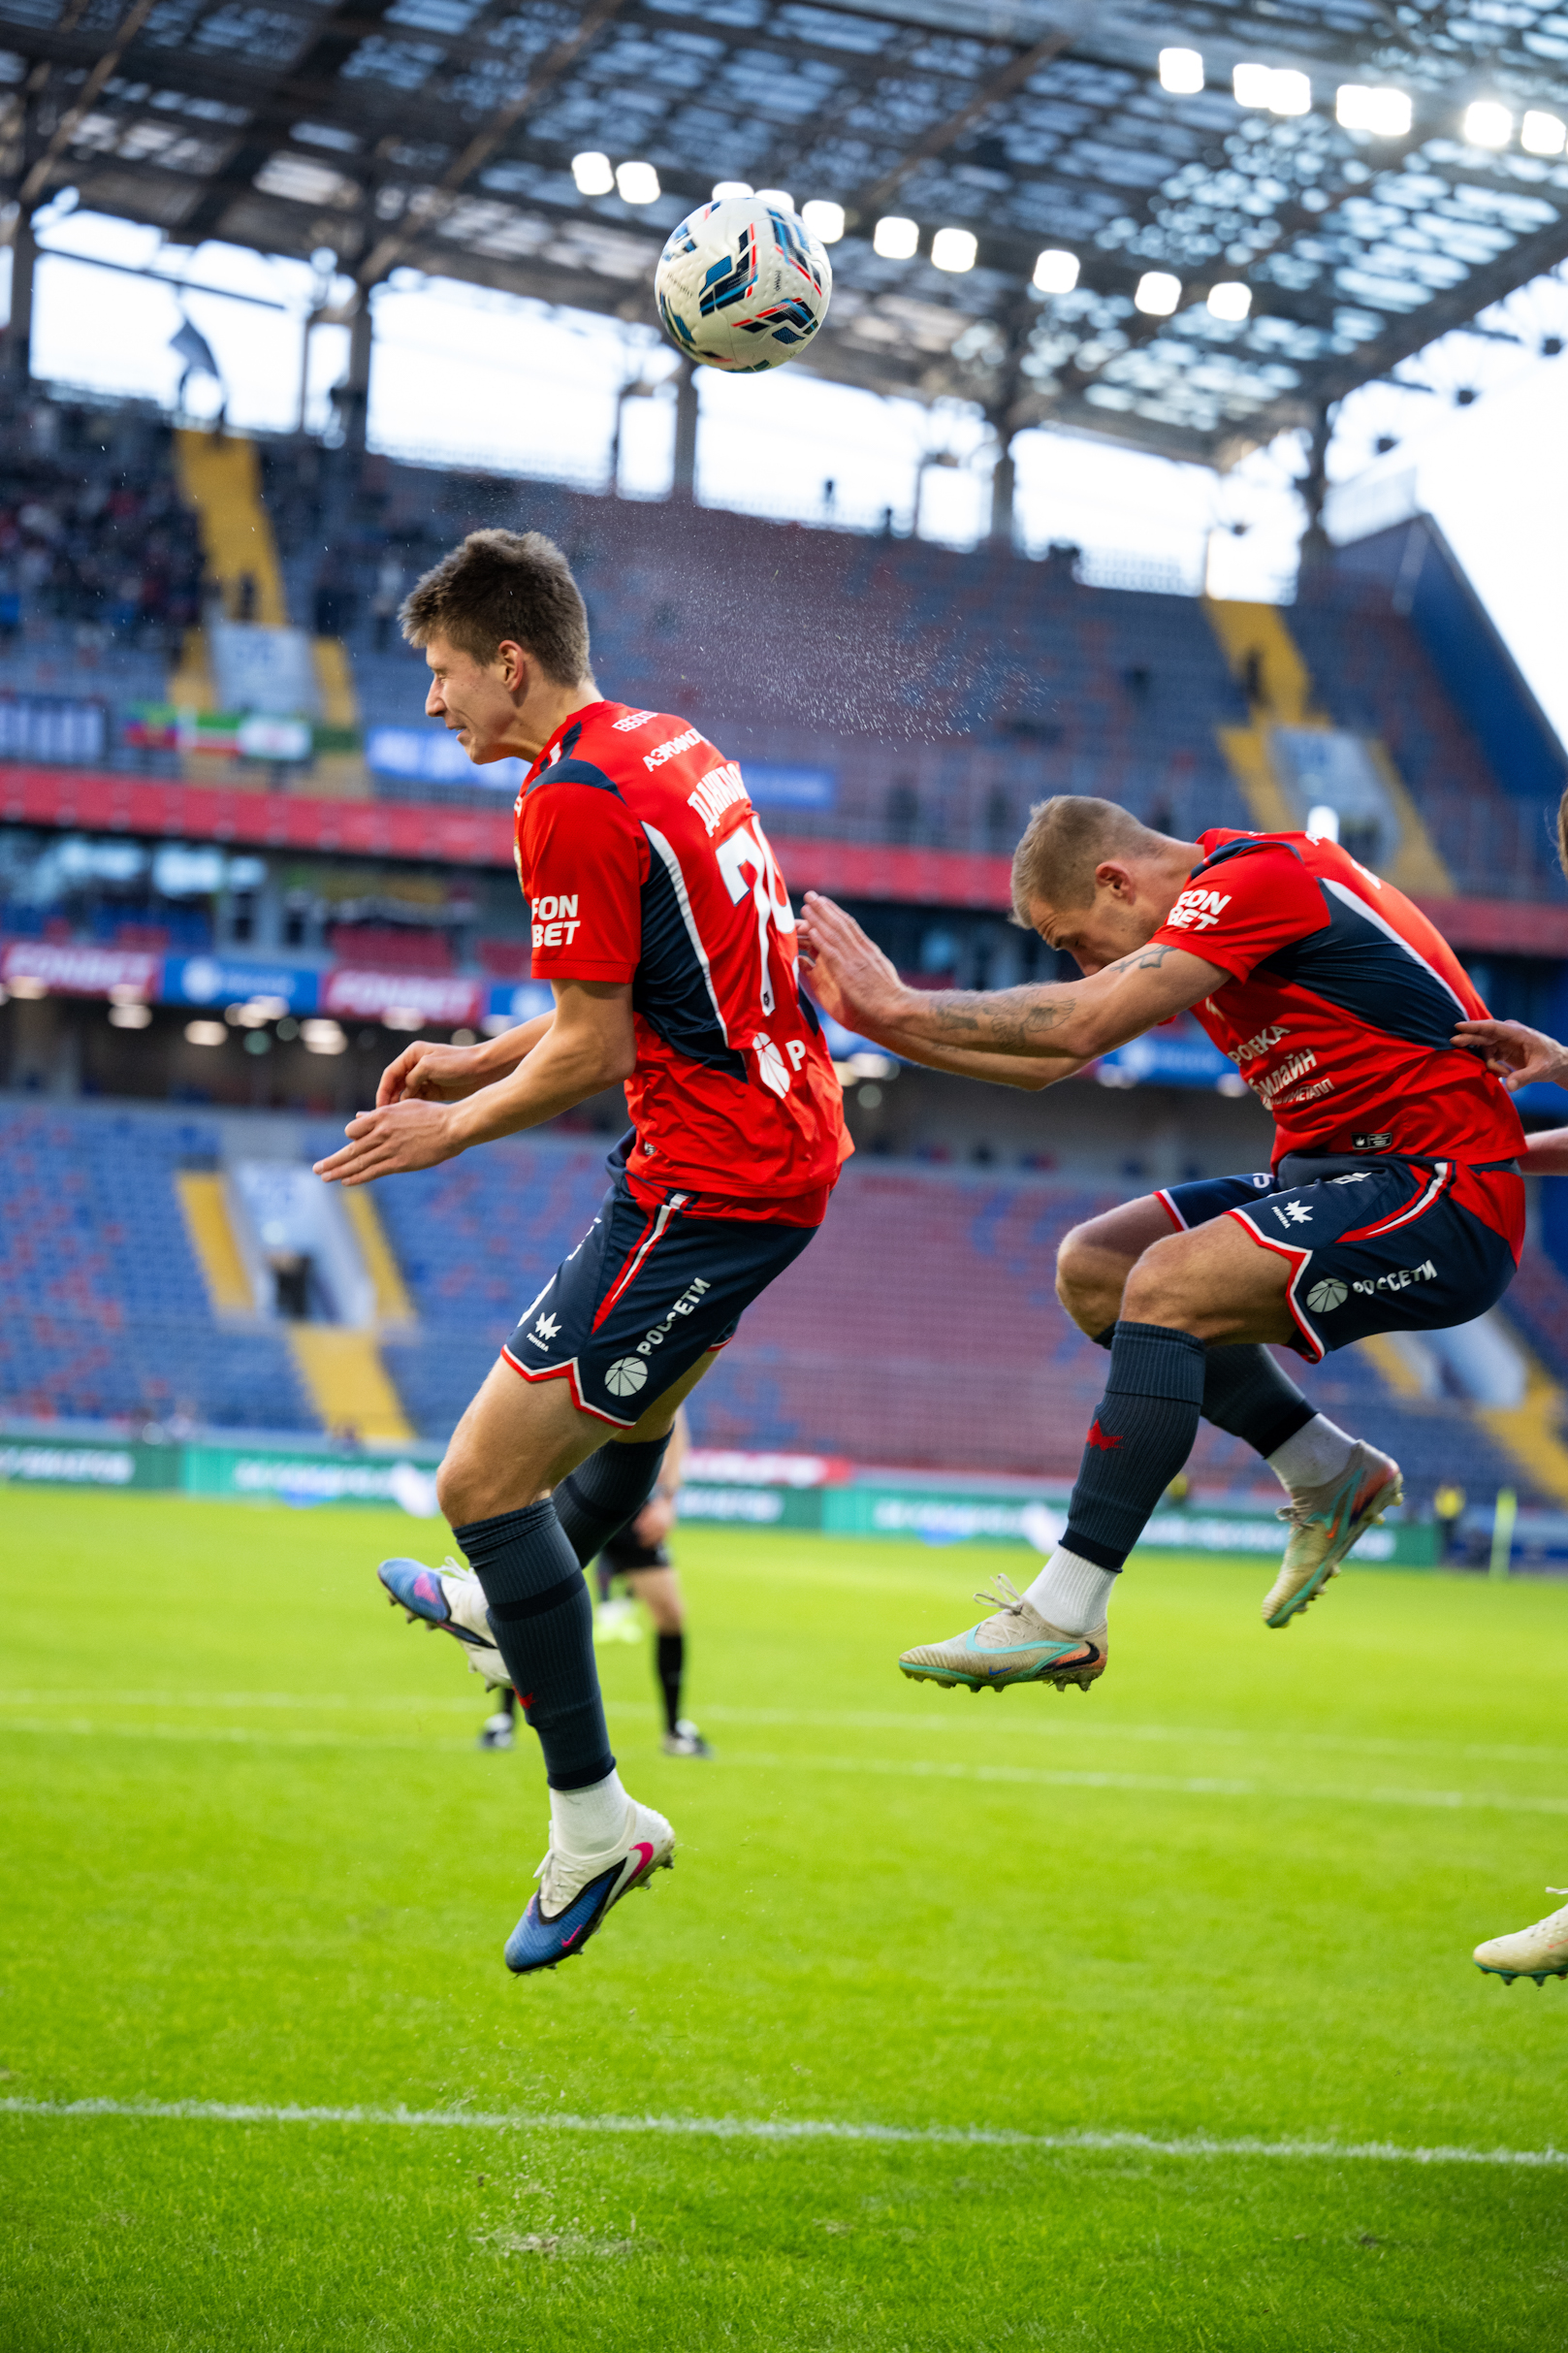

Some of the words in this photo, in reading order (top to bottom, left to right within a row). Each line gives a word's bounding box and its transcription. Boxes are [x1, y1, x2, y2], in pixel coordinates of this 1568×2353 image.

[1176, 888, 1232, 916] FON
[1166, 906, 1220, 931] BET
[531, 920, 581, 949] BET
[1352, 1259, 1438, 1296] РОССЕТИ
[636, 1276, 712, 1357] РОССЕТИ
